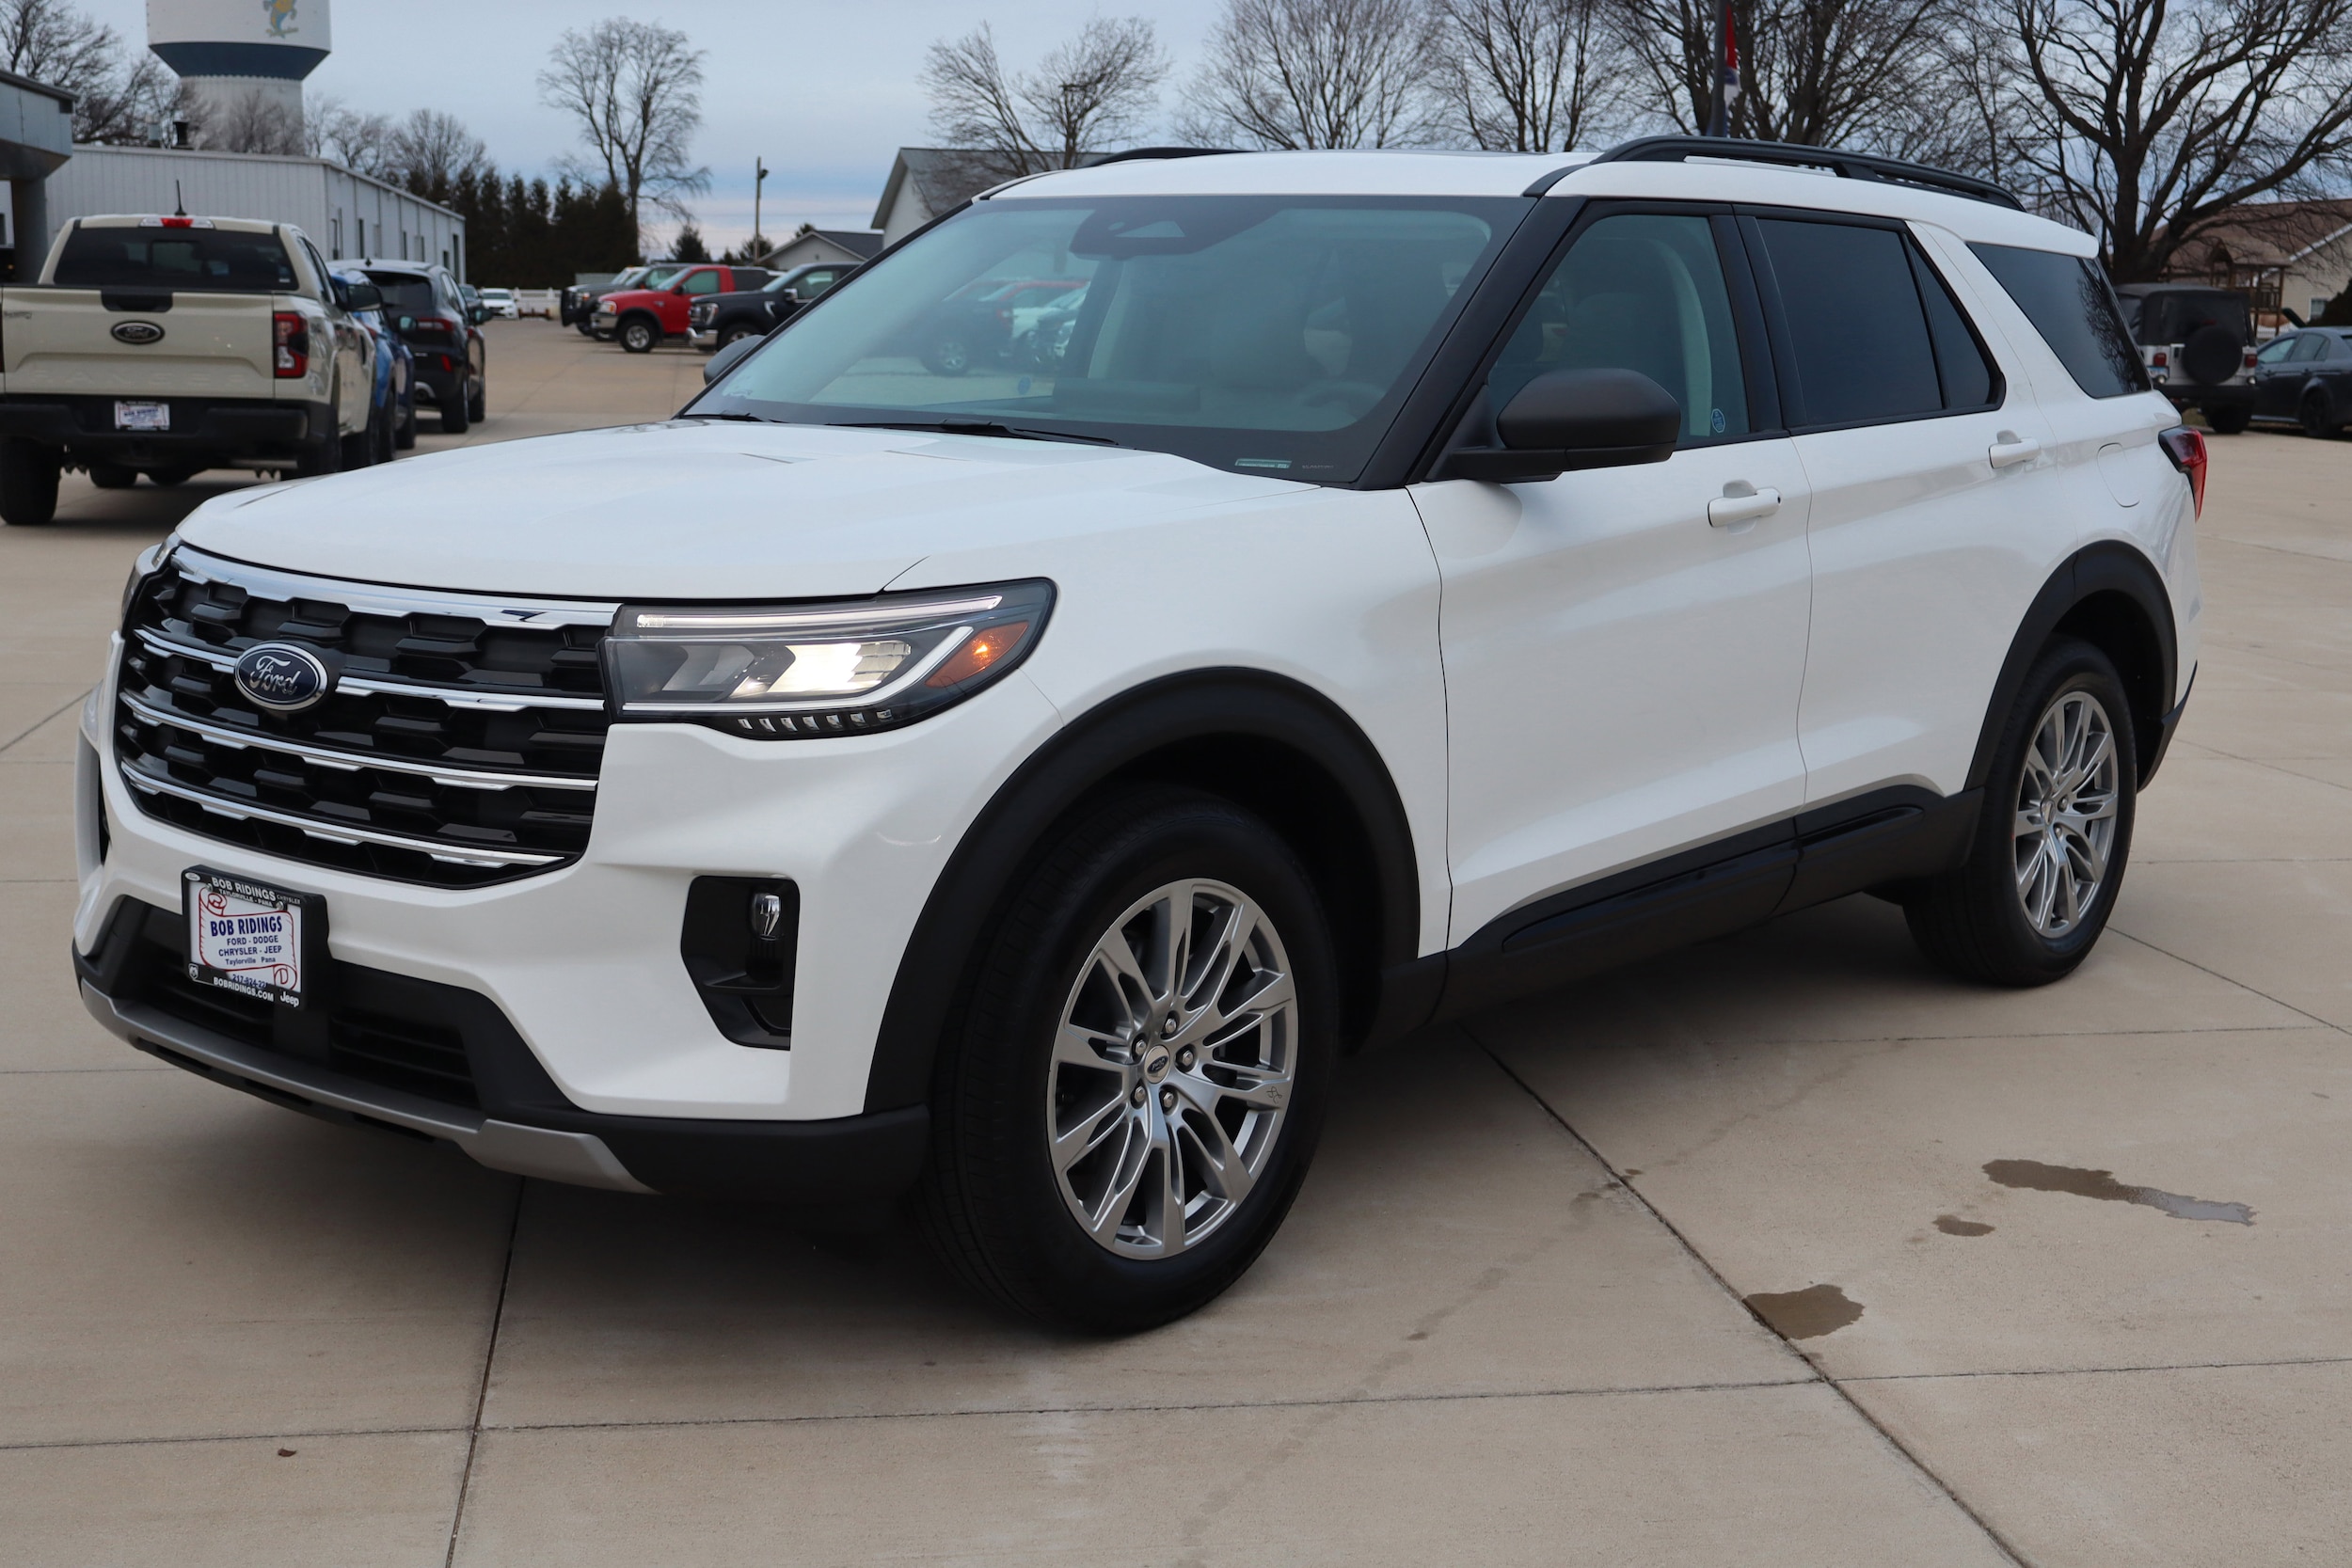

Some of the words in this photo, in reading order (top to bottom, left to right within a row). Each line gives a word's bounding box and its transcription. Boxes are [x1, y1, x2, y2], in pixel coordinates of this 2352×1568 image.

[249, 655, 301, 696] Ford
[212, 877, 232, 891] BOB
[235, 881, 277, 901] RIDINGS
[218, 888, 254, 904] TAYLORVILLE
[258, 898, 274, 908] PANA
[210, 919, 234, 937] BOB
[238, 915, 282, 936] RIDINGS
[227, 936, 247, 946] FORD
[253, 935, 278, 945] DODGE
[218, 946, 258, 958] CHRYSLER
[263, 945, 282, 955] JEEP
[225, 958, 257, 967] Taylorville
[261, 956, 276, 964] Pana
[213, 975, 275, 1003] BOBRIDINGS.COM
[279, 990, 300, 1008] Jeep
